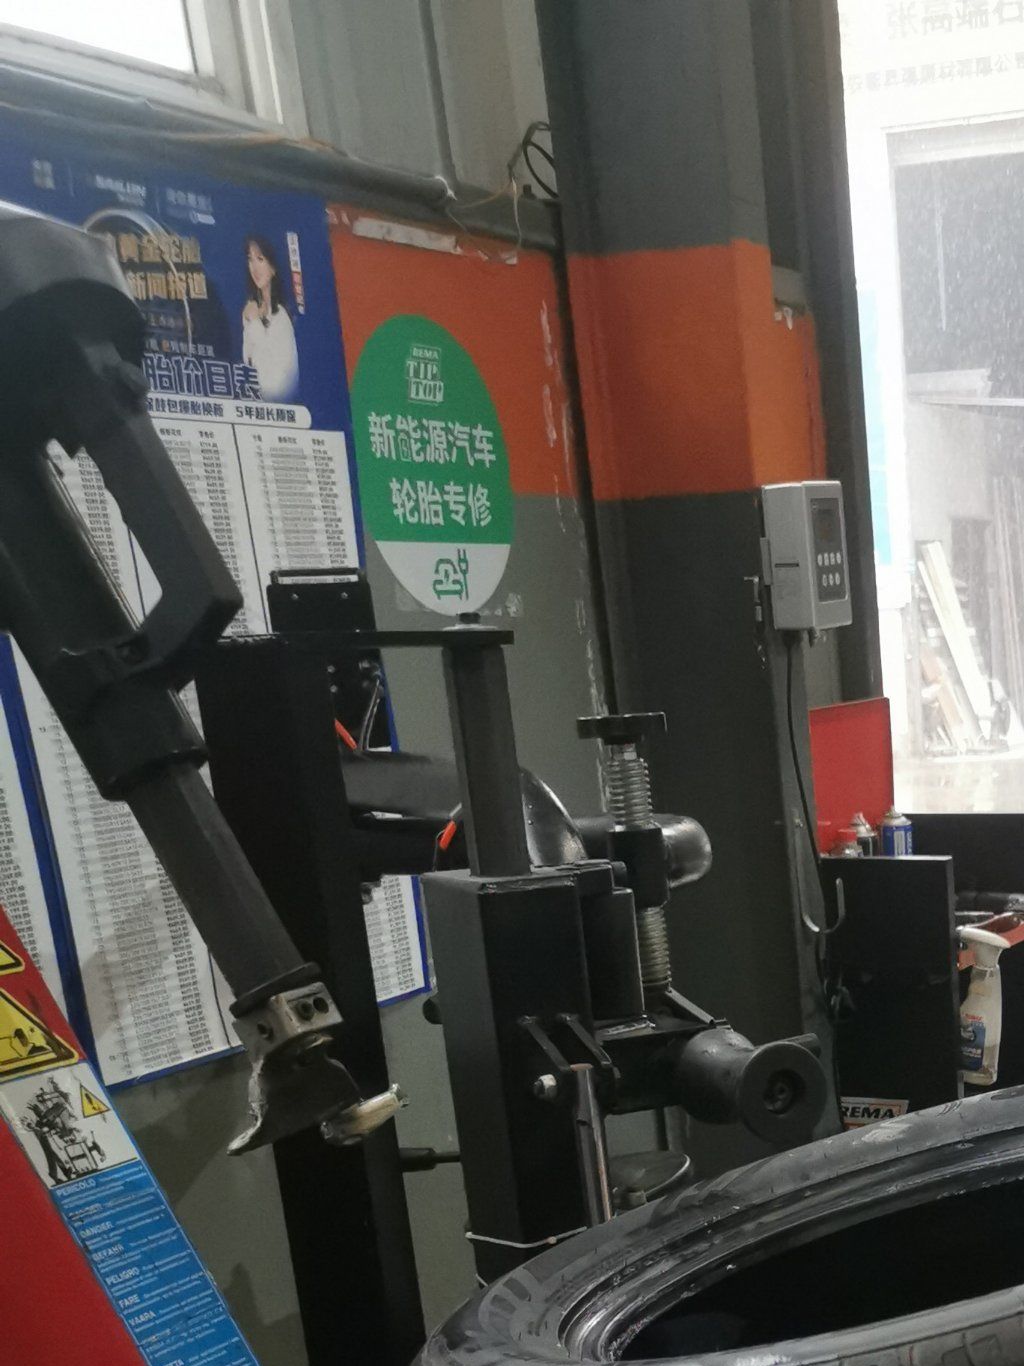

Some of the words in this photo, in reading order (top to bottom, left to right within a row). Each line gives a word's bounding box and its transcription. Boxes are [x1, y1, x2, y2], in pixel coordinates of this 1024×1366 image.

[406, 360, 439, 380] TIP
[412, 379, 443, 402] TOP
[368, 412, 496, 468] 新能源汽车
[389, 478, 492, 527] 轮胎专修
[106, 1267, 140, 1286] PELIGRO
[119, 1294, 140, 1309] FARE
